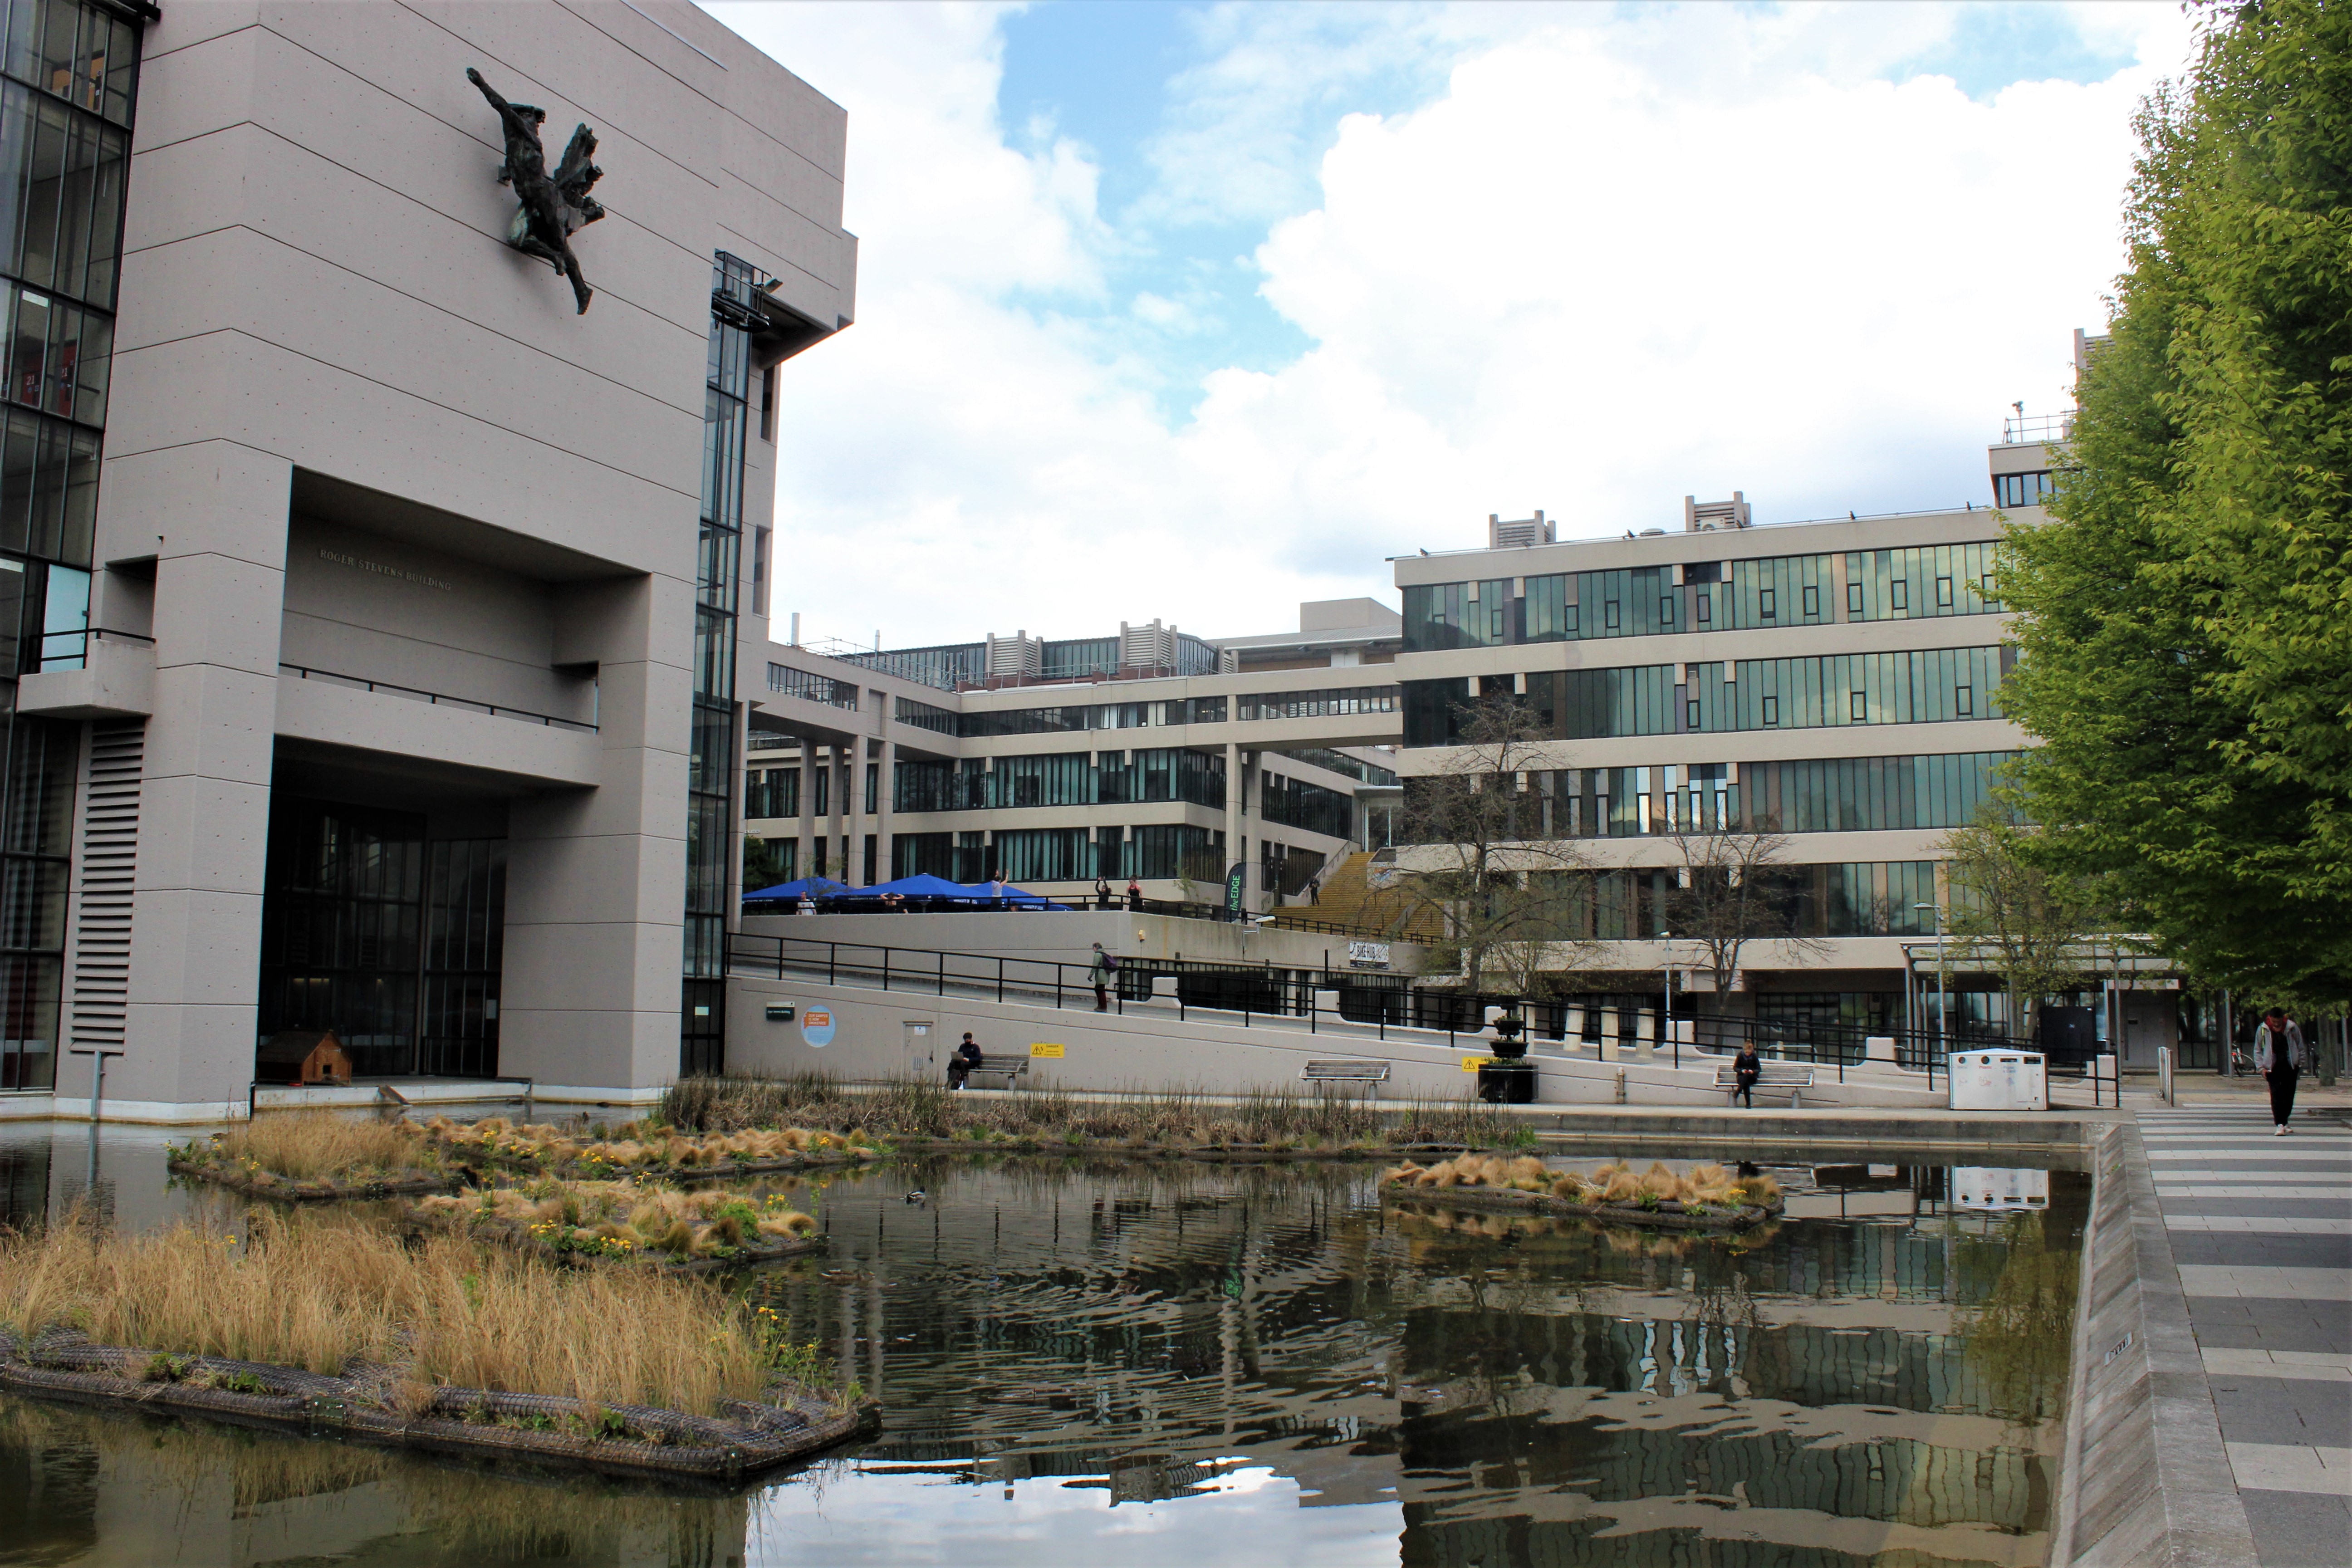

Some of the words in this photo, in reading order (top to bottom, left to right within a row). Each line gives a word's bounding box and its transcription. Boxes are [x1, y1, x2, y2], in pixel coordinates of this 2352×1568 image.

[320, 549, 354, 566] ROGER
[358, 559, 402, 578] STEVENS
[406, 572, 451, 591] BUILDING
[1230, 875, 1240, 898] EDGE
[1367, 944, 1376, 959] HUB
